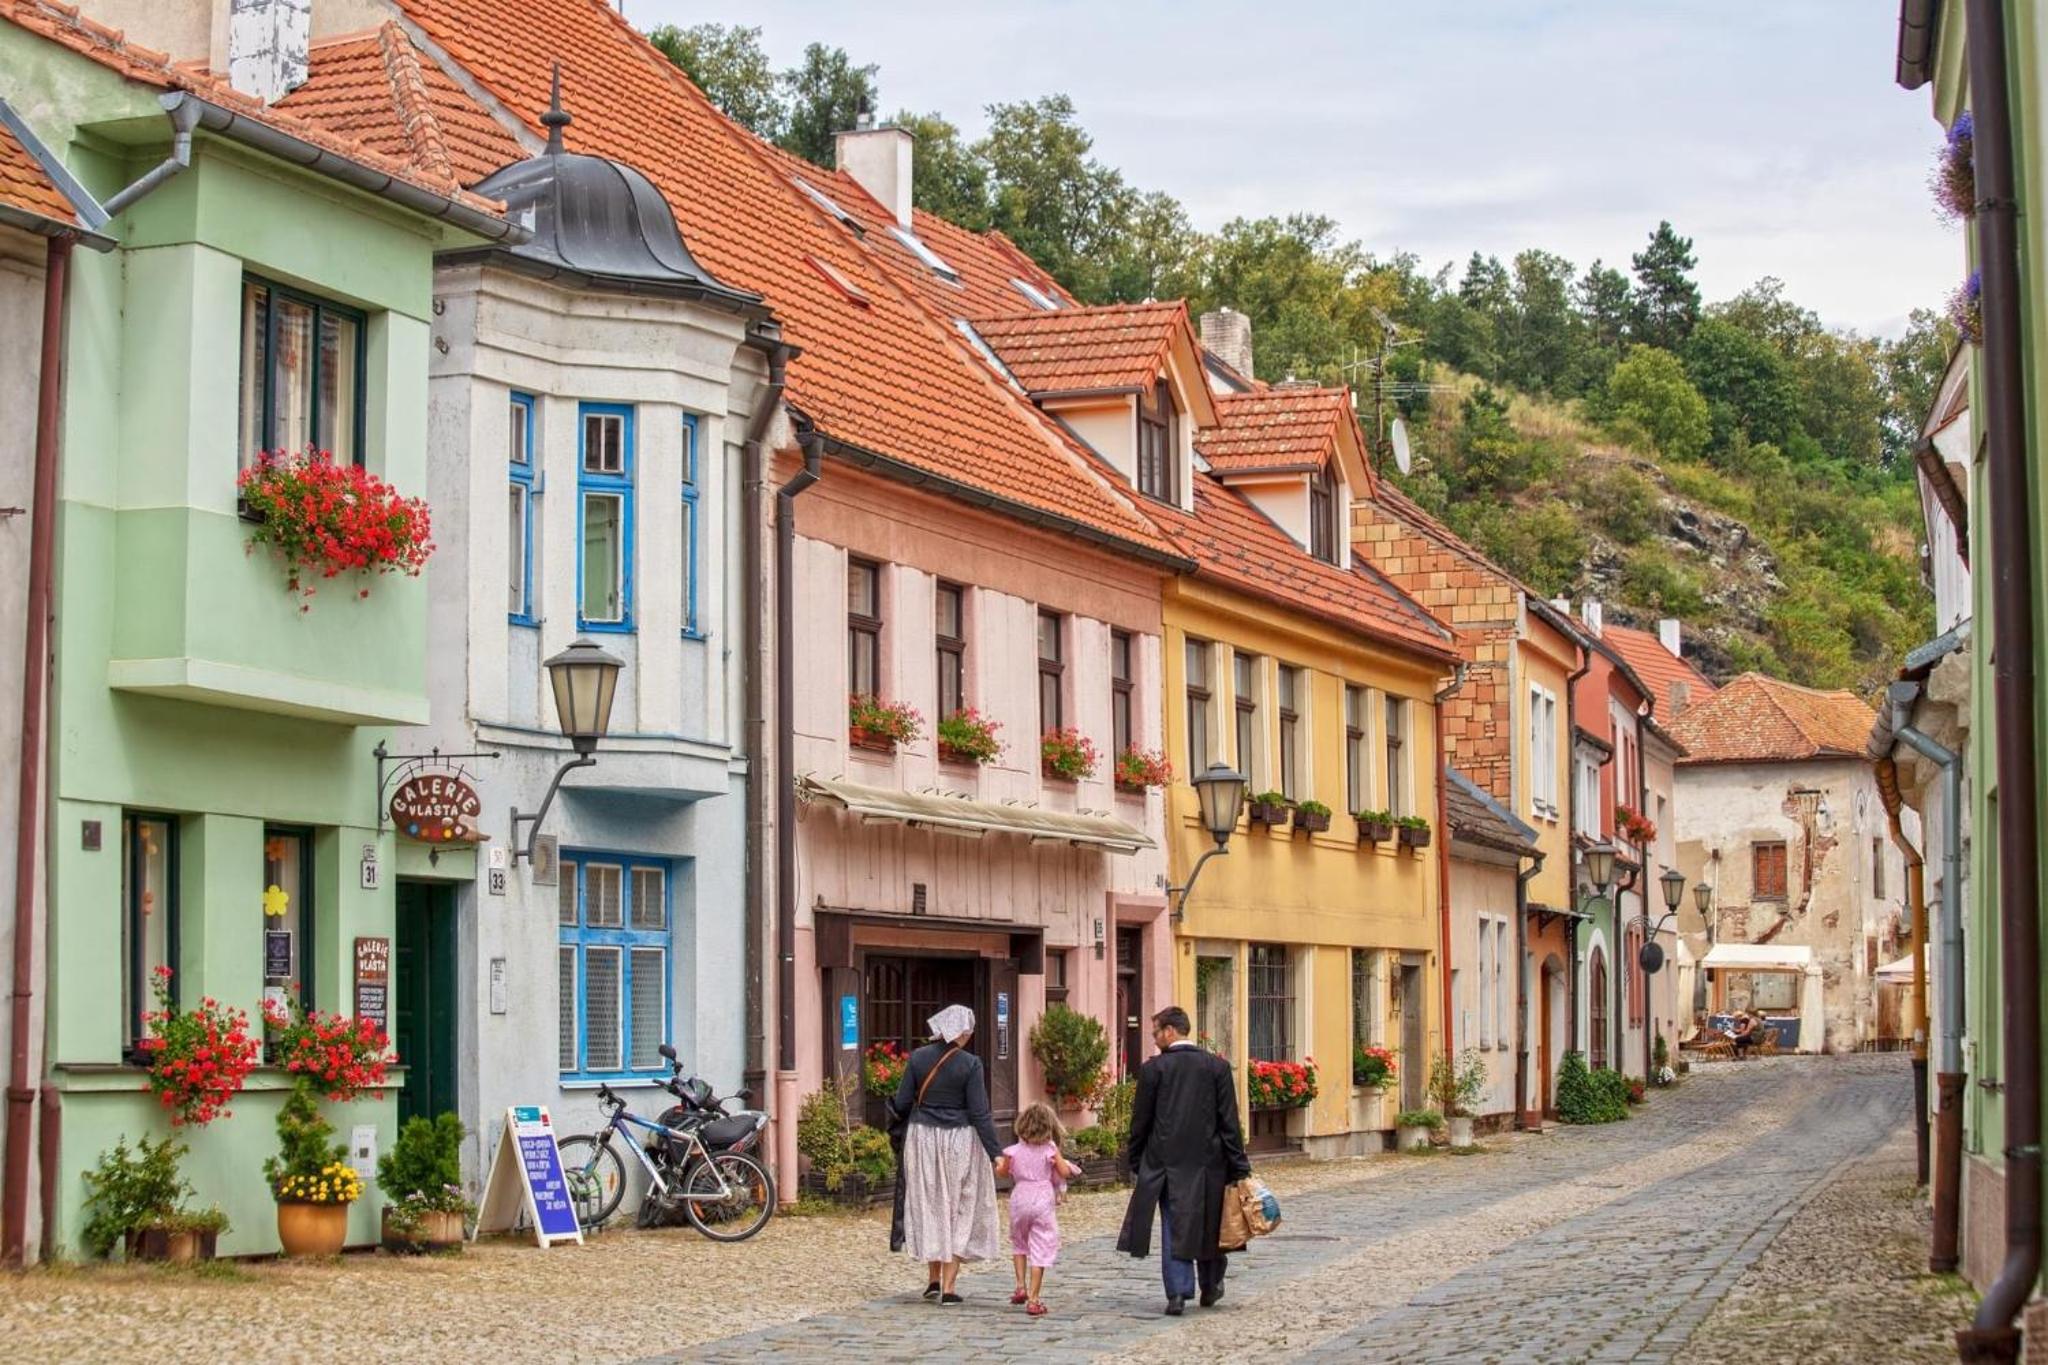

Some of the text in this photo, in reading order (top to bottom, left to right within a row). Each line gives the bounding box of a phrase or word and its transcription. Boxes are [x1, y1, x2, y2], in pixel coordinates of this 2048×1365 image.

[409, 804, 459, 817] VLASTA
[365, 865, 376, 884] 31
[492, 873, 503, 890] 33
[360, 959, 386, 971] VLASTA
